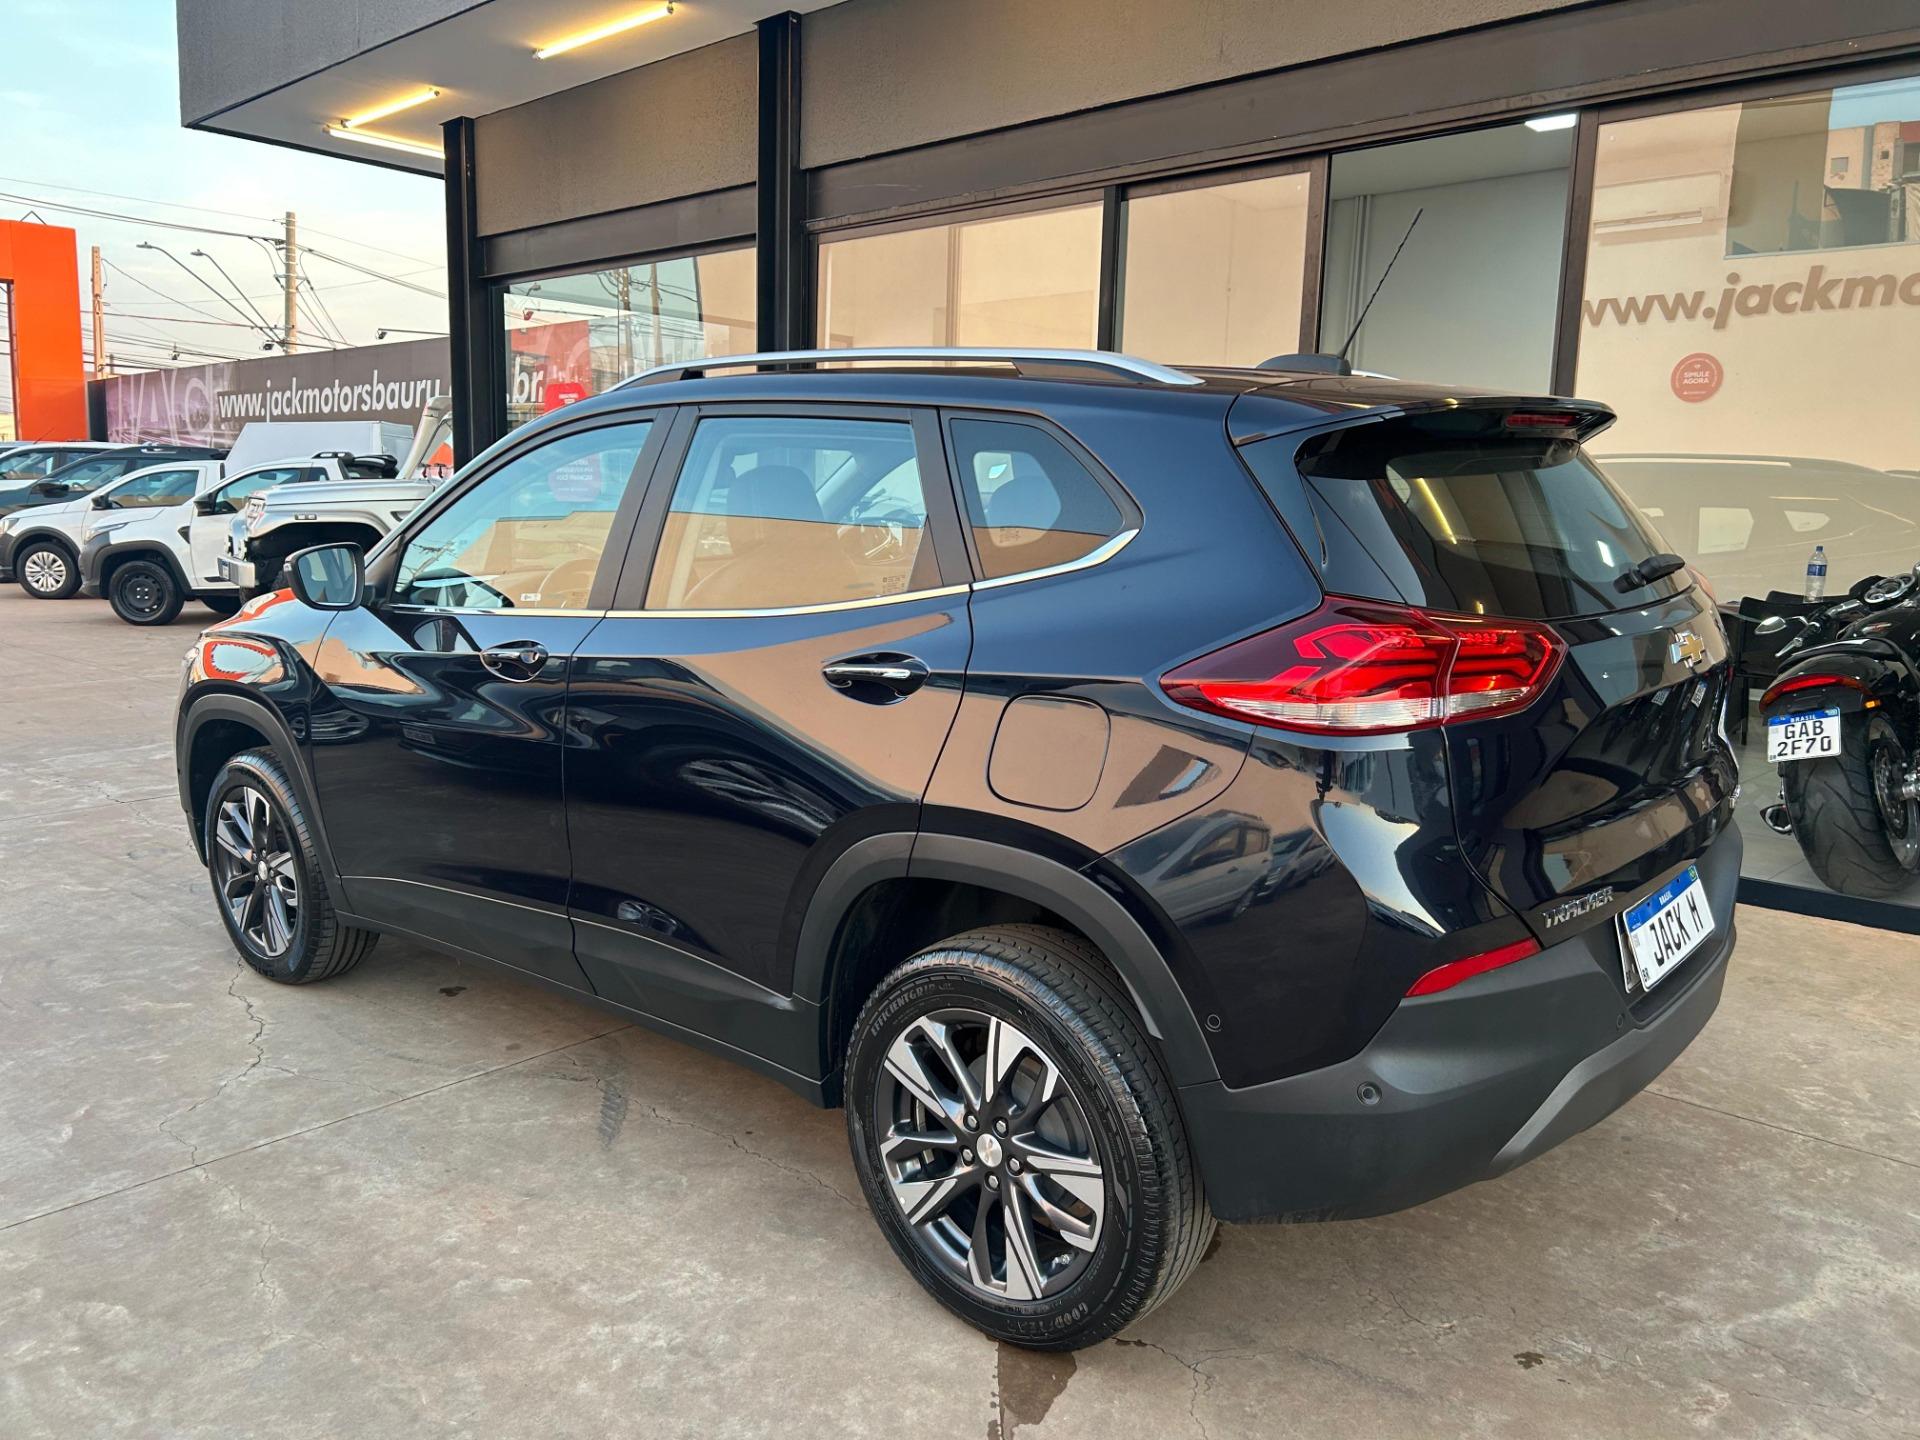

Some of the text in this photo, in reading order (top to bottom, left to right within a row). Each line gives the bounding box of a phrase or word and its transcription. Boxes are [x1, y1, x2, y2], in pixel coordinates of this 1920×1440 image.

[1682, 377, 1710, 385] AGORA
[1790, 714, 1816, 723] BRASIL
[1784, 720, 1824, 740] GAB
[1777, 736, 1831, 757] 2F70
[1542, 886, 1614, 929] TRACKER
[1649, 902, 1691, 968] JACK
